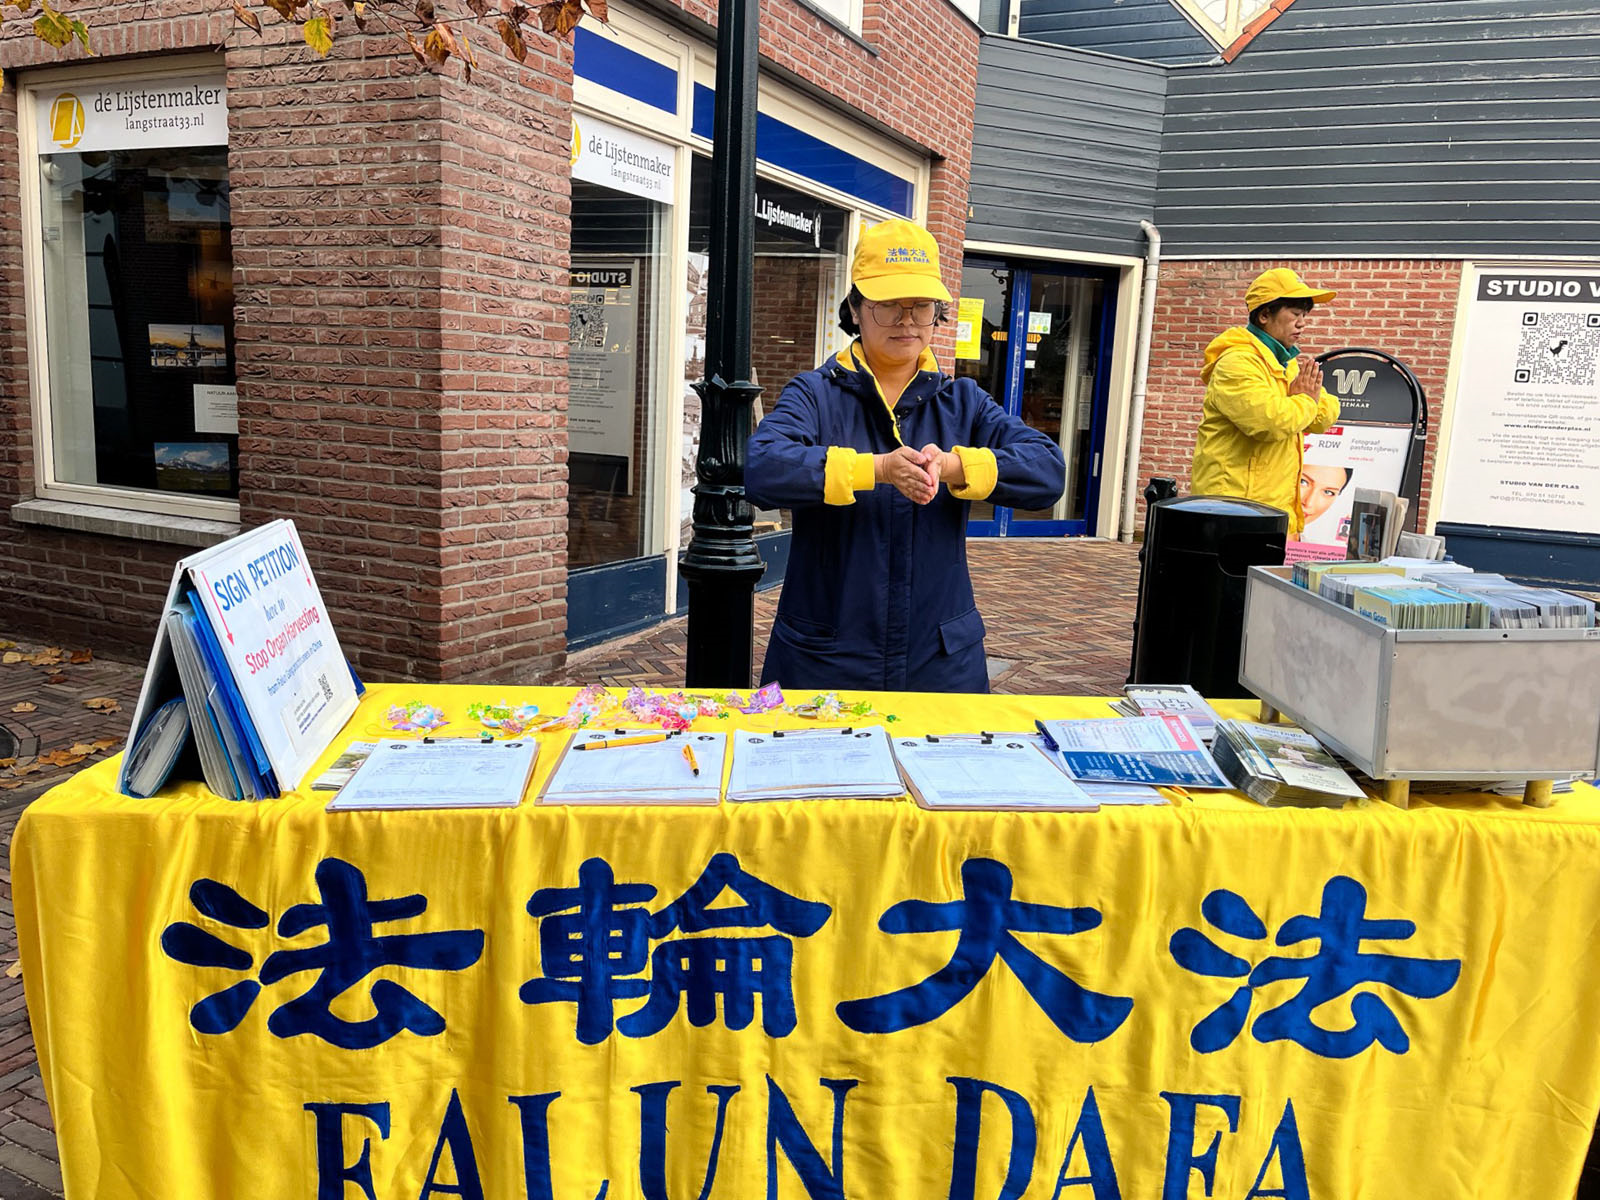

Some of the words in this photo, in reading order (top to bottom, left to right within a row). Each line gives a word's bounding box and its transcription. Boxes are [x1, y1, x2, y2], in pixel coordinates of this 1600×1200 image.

[94, 93, 112, 113] dé
[116, 85, 221, 116] Lijstenmaker
[125, 113, 205, 132] langstraat33.nl
[588, 135, 602, 155] dé
[605, 141, 671, 177] Lijstenmaker
[610, 165, 661, 190] langstraat33.nl
[1486, 279, 1582, 297] STUDIO
[1318, 440, 1341, 449] RDW
[214, 569, 252, 611] SIGN
[247, 541, 300, 591] PETITION
[245, 649, 270, 675] Stop
[265, 631, 289, 658] Organ
[284, 606, 320, 643] Harvesting
[161, 852, 1461, 1059] 法輪大法
[304, 1073, 858, 1200] FALUN
[946, 1076, 1312, 1200] DAFA
